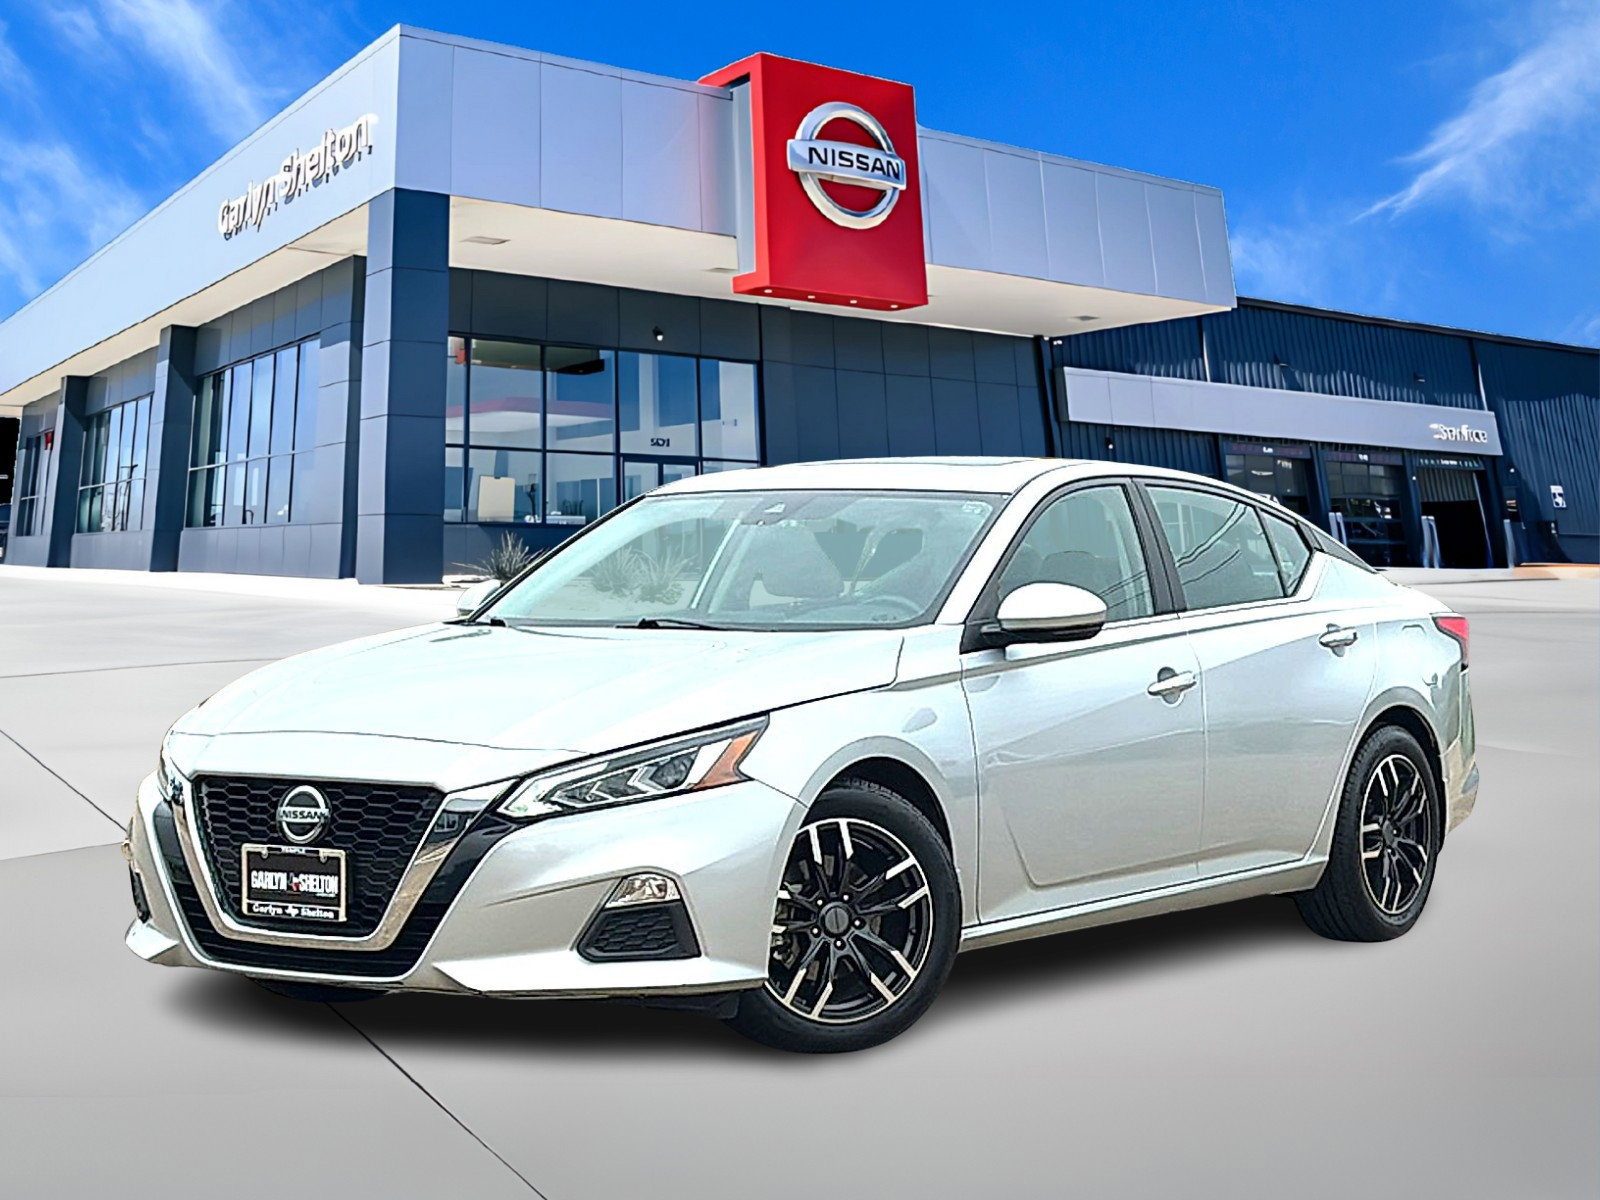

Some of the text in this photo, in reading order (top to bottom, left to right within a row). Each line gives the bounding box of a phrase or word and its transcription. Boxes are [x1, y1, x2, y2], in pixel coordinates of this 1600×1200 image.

[279, 118, 374, 203] Shelton
[808, 147, 900, 180] NISSAN
[280, 810, 329, 820] NISSAN
[251, 870, 339, 894] GARLYN SHELTON
